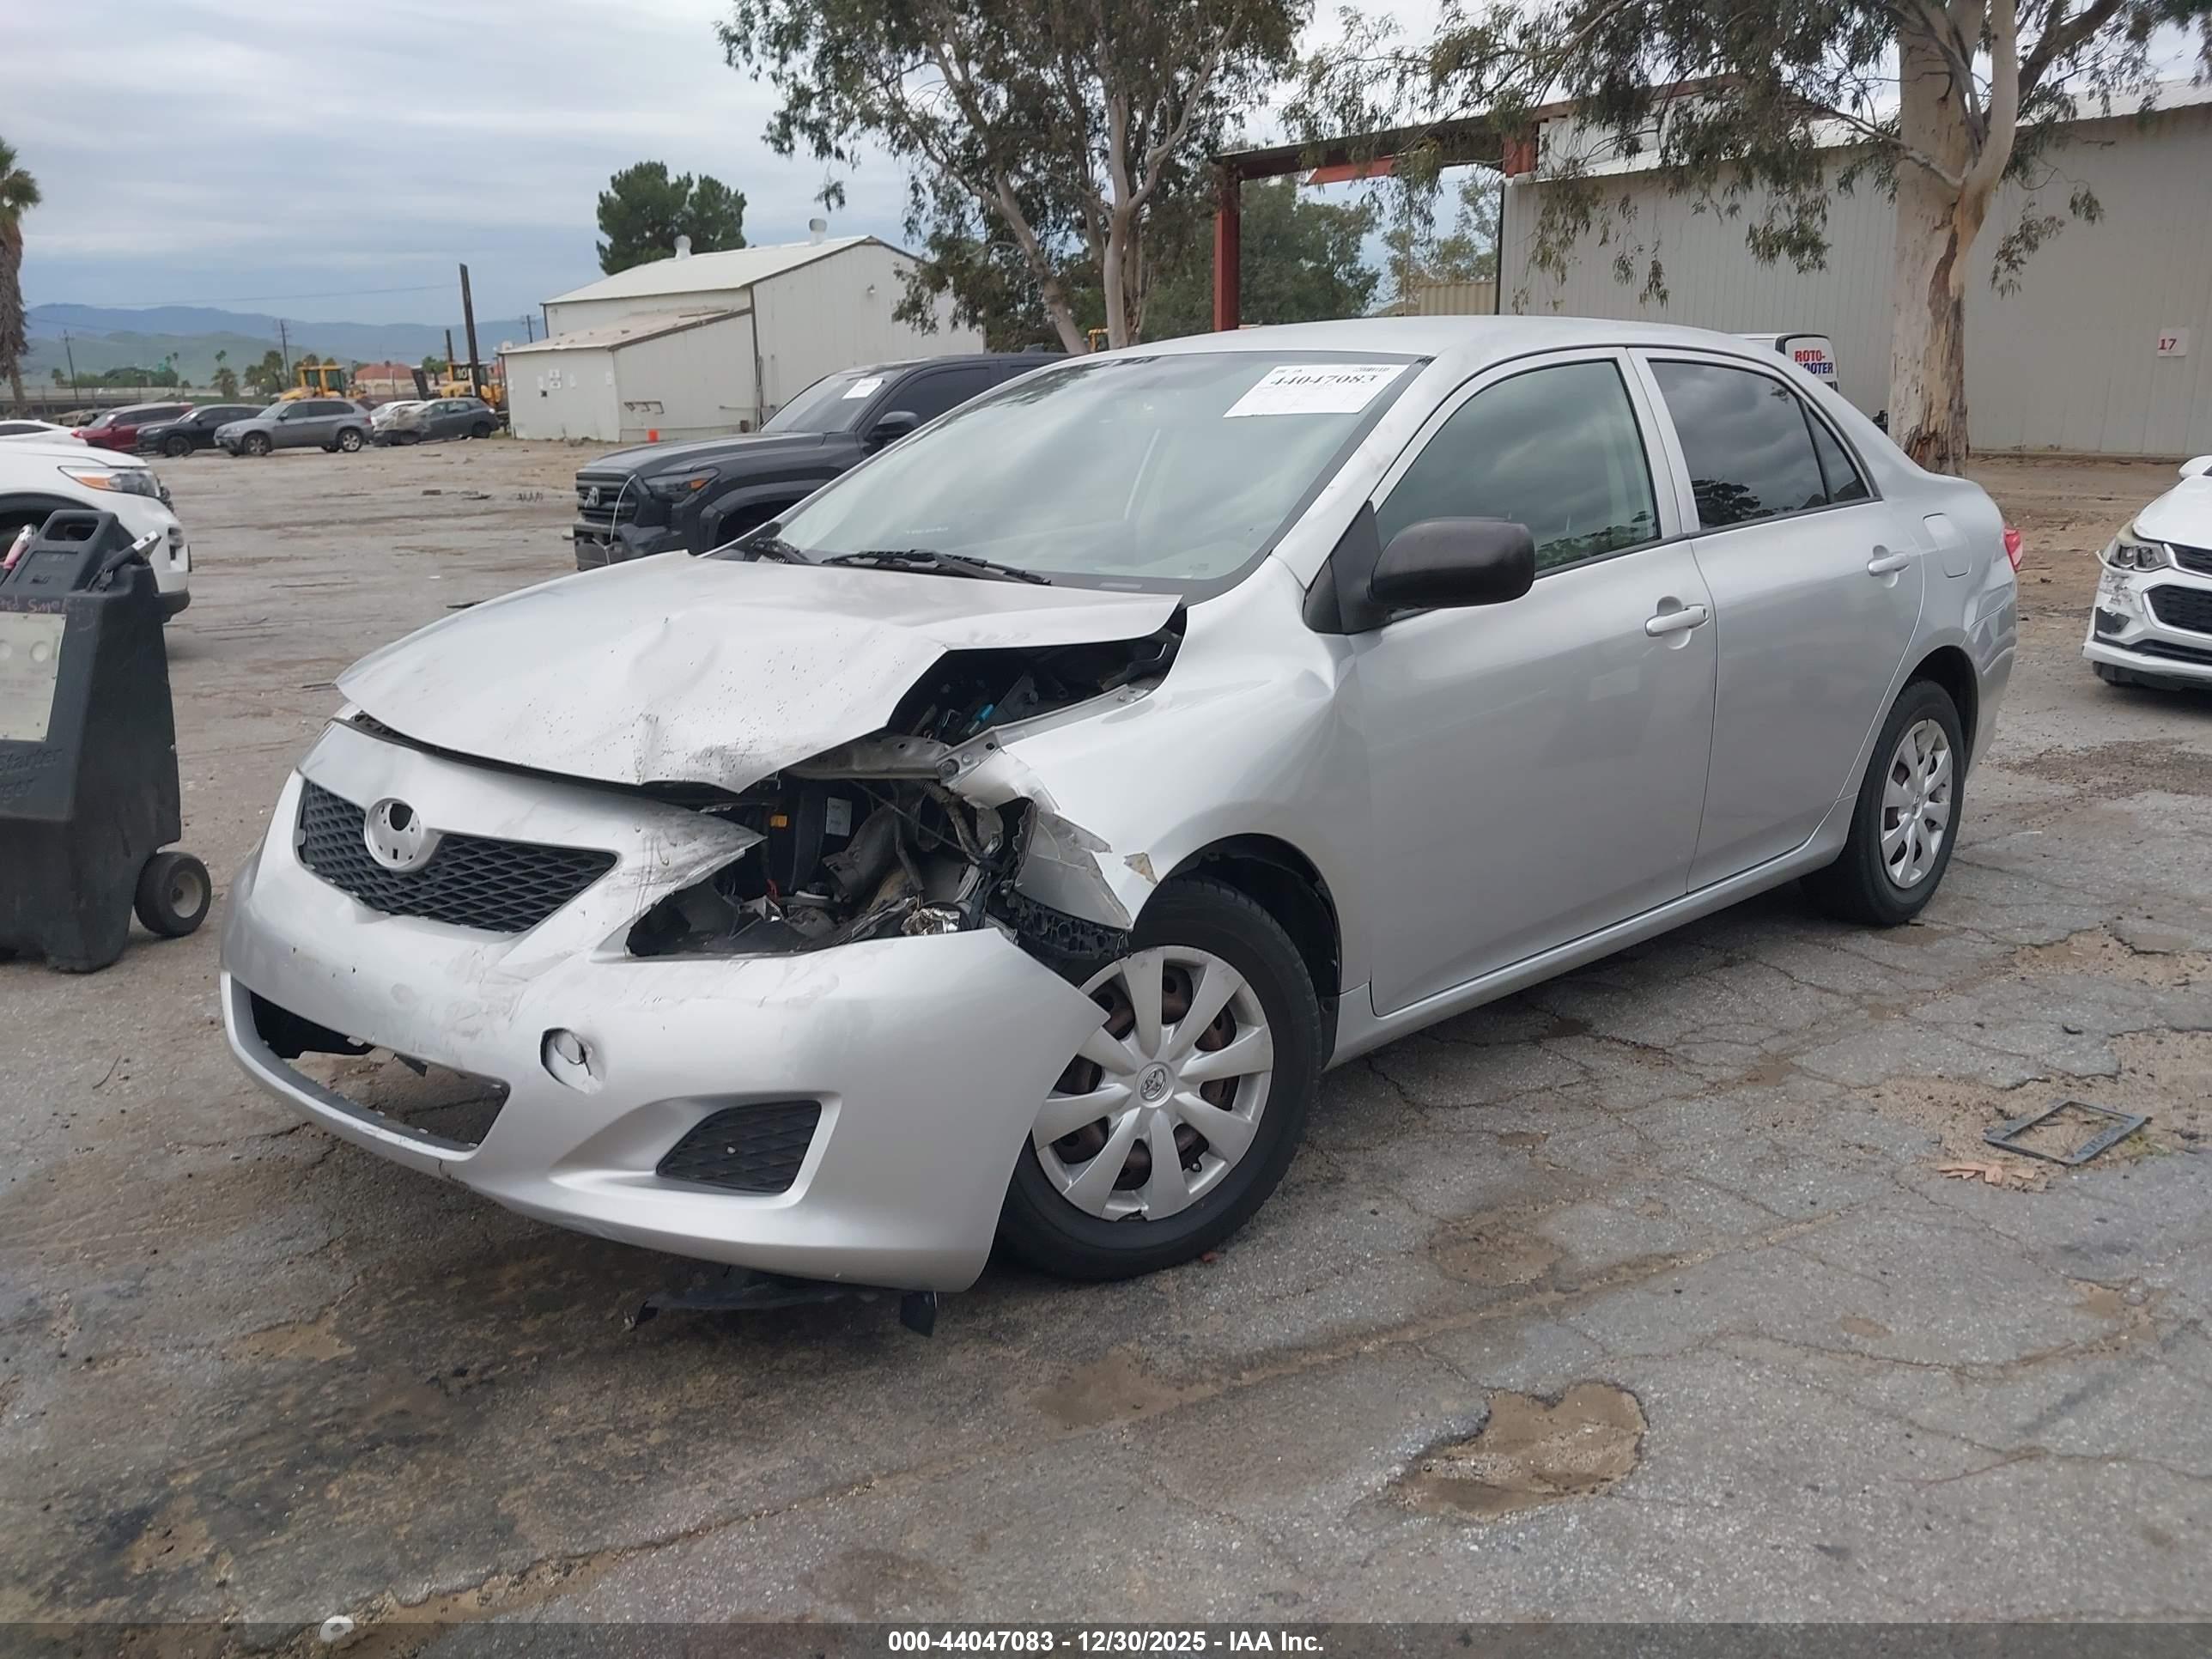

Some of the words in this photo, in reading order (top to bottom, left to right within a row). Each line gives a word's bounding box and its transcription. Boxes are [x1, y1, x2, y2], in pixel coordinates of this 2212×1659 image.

[2157, 338, 2177, 350] 17
[1795, 349, 1826, 362] ROTO-
[1798, 362, 1833, 374] OOTER
[1271, 374, 1378, 386] 44047083
